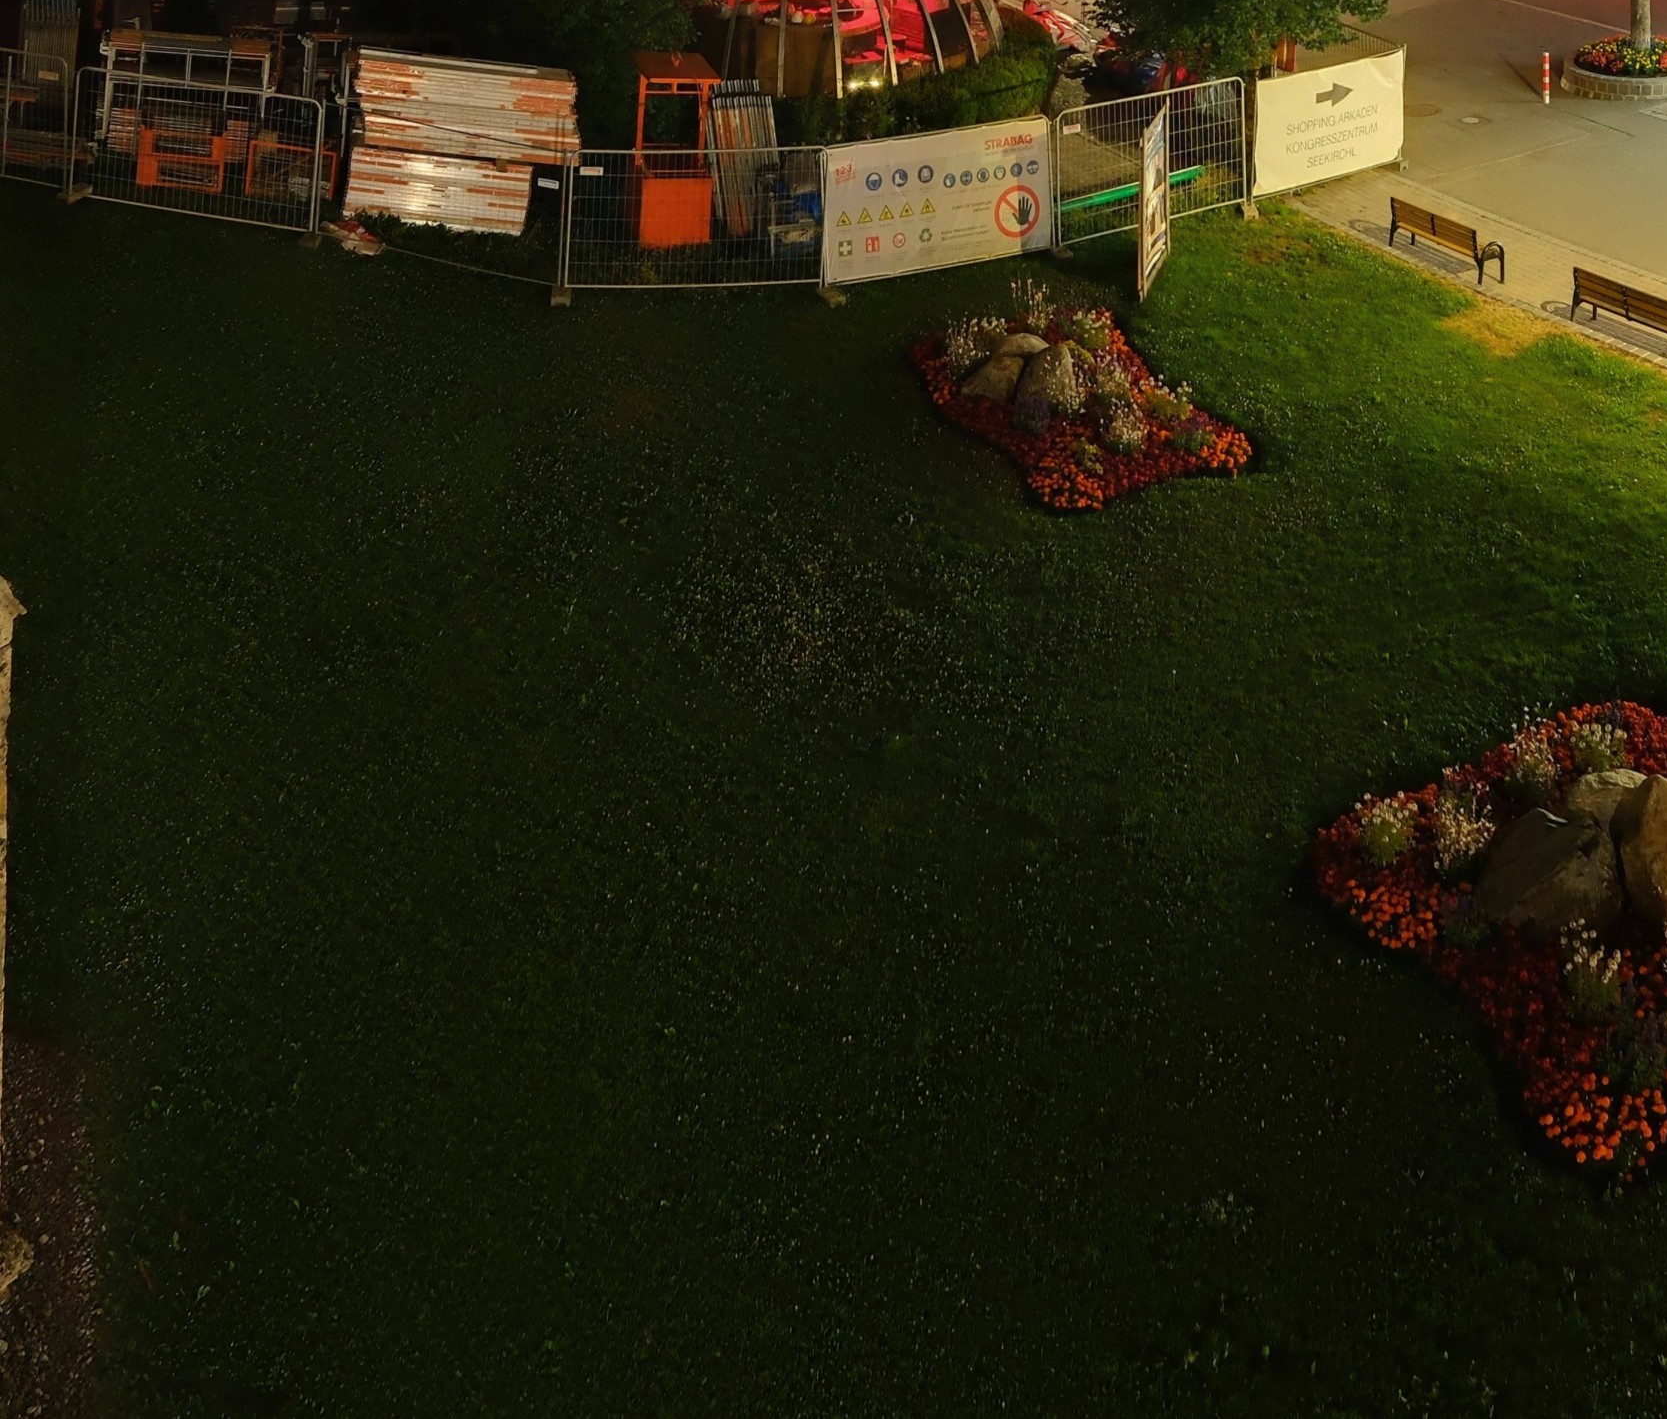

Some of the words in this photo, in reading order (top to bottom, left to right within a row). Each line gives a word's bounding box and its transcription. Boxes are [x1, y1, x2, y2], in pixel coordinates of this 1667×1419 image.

[1286, 115, 1337, 136] SHOPPING
[1337, 104, 1379, 125] ARKADEN
[984, 133, 1034, 152] STRABAG
[1285, 122, 1379, 155] KONGRESSZENTRUM
[1306, 146, 1358, 169] SEEKIRCHL
